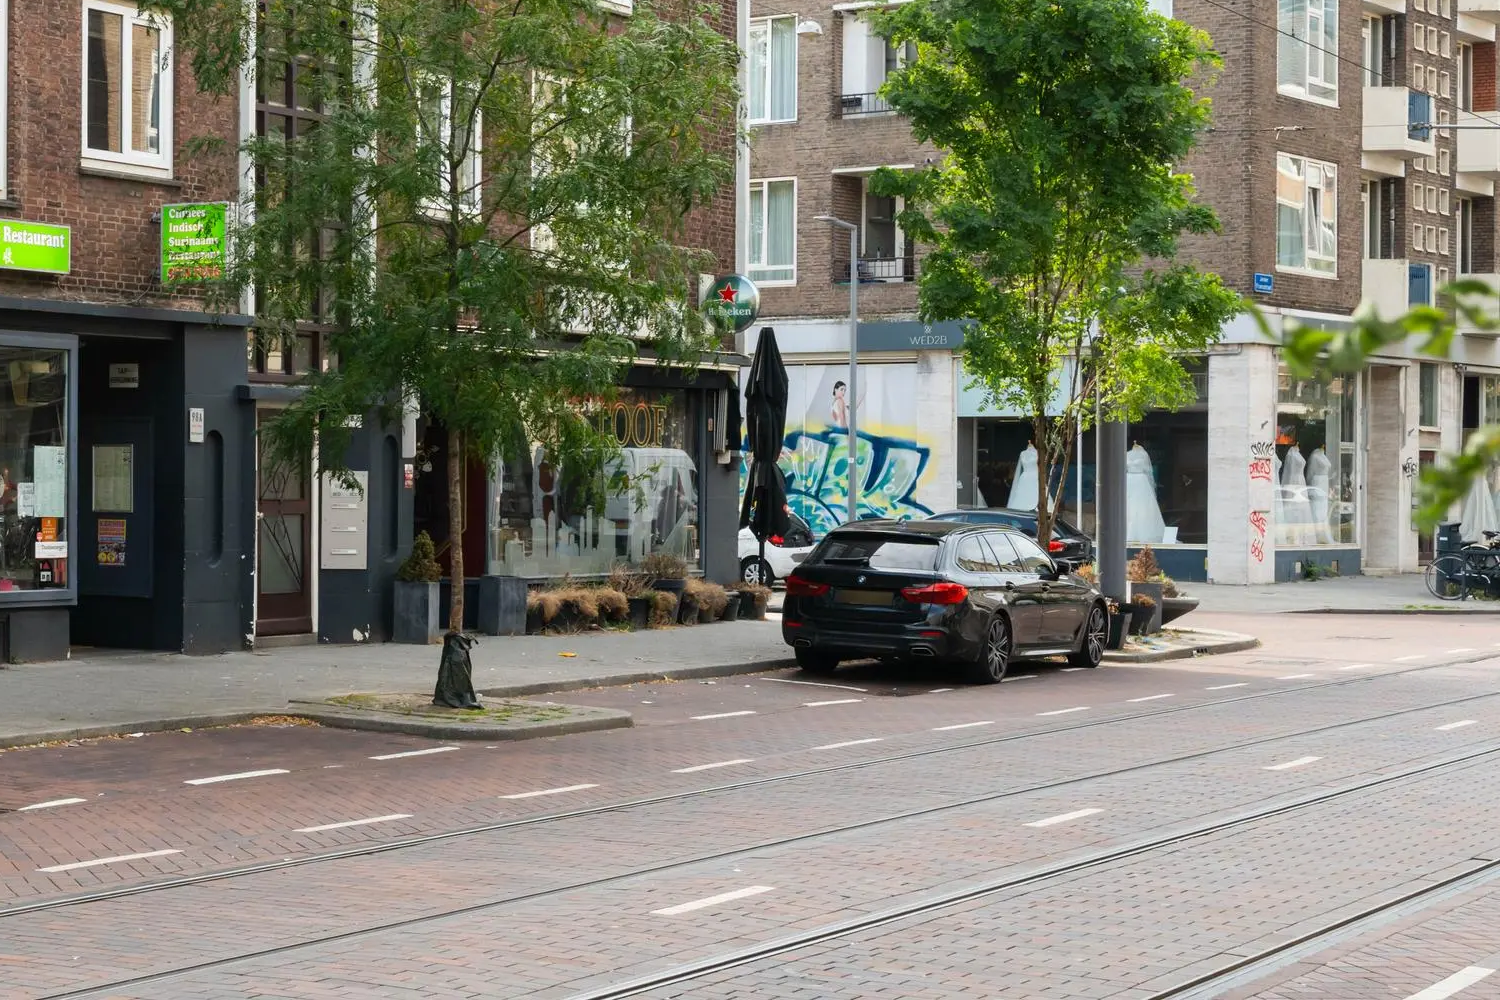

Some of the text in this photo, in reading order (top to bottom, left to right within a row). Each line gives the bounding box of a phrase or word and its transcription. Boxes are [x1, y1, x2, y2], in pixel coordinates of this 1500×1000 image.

[168, 221, 204, 233] Indisch
[3, 226, 65, 249] Restaurant
[708, 305, 752, 317] Hneken
[909, 335, 948, 345] WED2B
